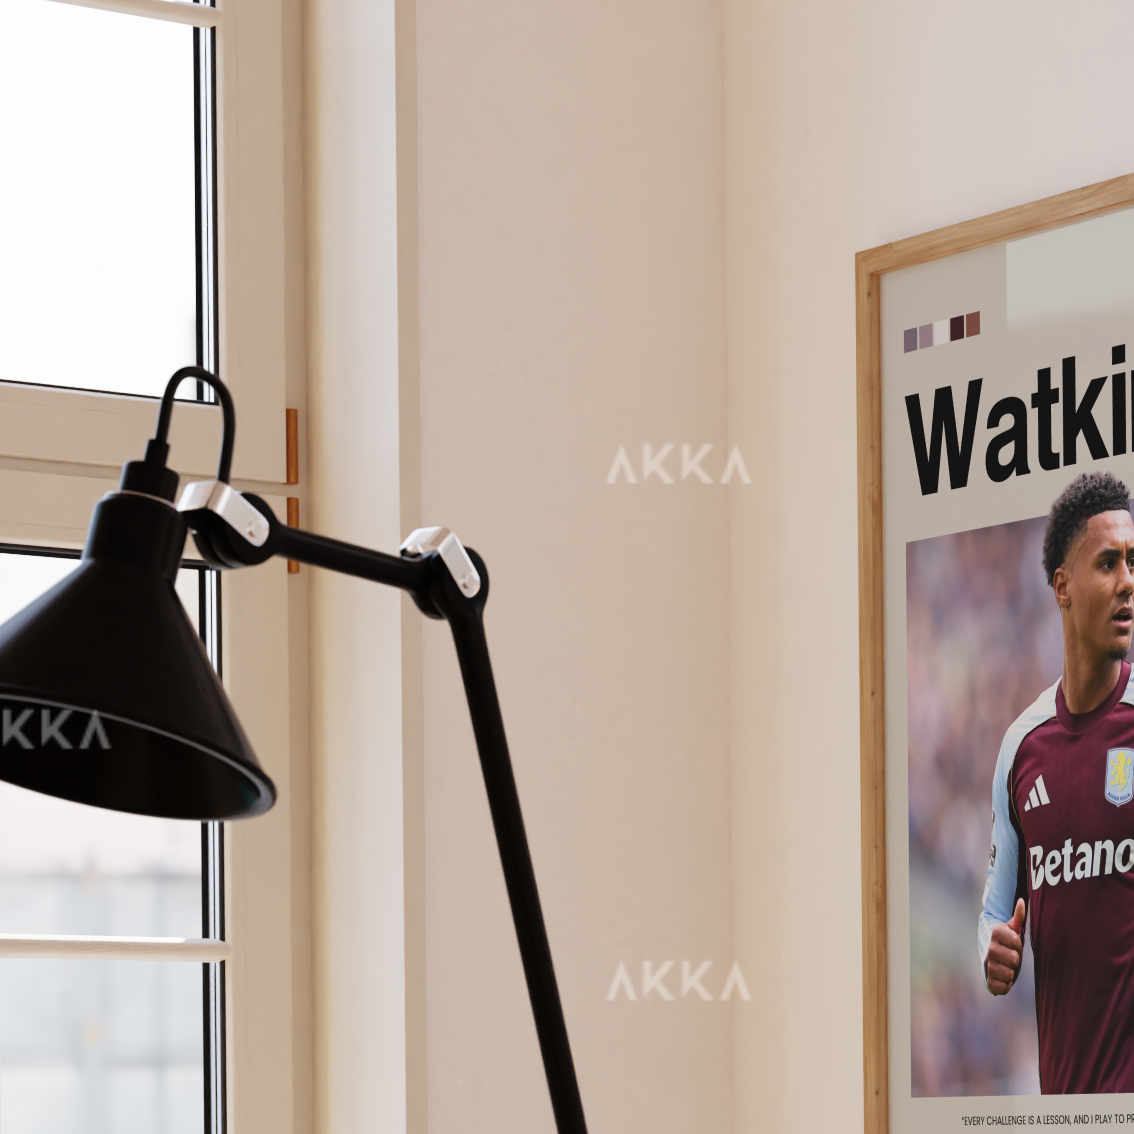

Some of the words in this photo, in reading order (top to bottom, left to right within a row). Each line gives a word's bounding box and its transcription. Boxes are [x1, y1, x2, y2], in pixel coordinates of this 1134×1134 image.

[987, 1116, 1026, 1125] CHALLENGE
[1028, 1115, 1034, 1125] IS
[1036, 1115, 1041, 1125] A
[1043, 1115, 1071, 1125] LESSON,
[1074, 1115, 1089, 1124] AND
[1091, 1115, 1093, 1124] I
[1095, 1114, 1112, 1124] PLAY
[1114, 1114, 1124, 1124] TO
